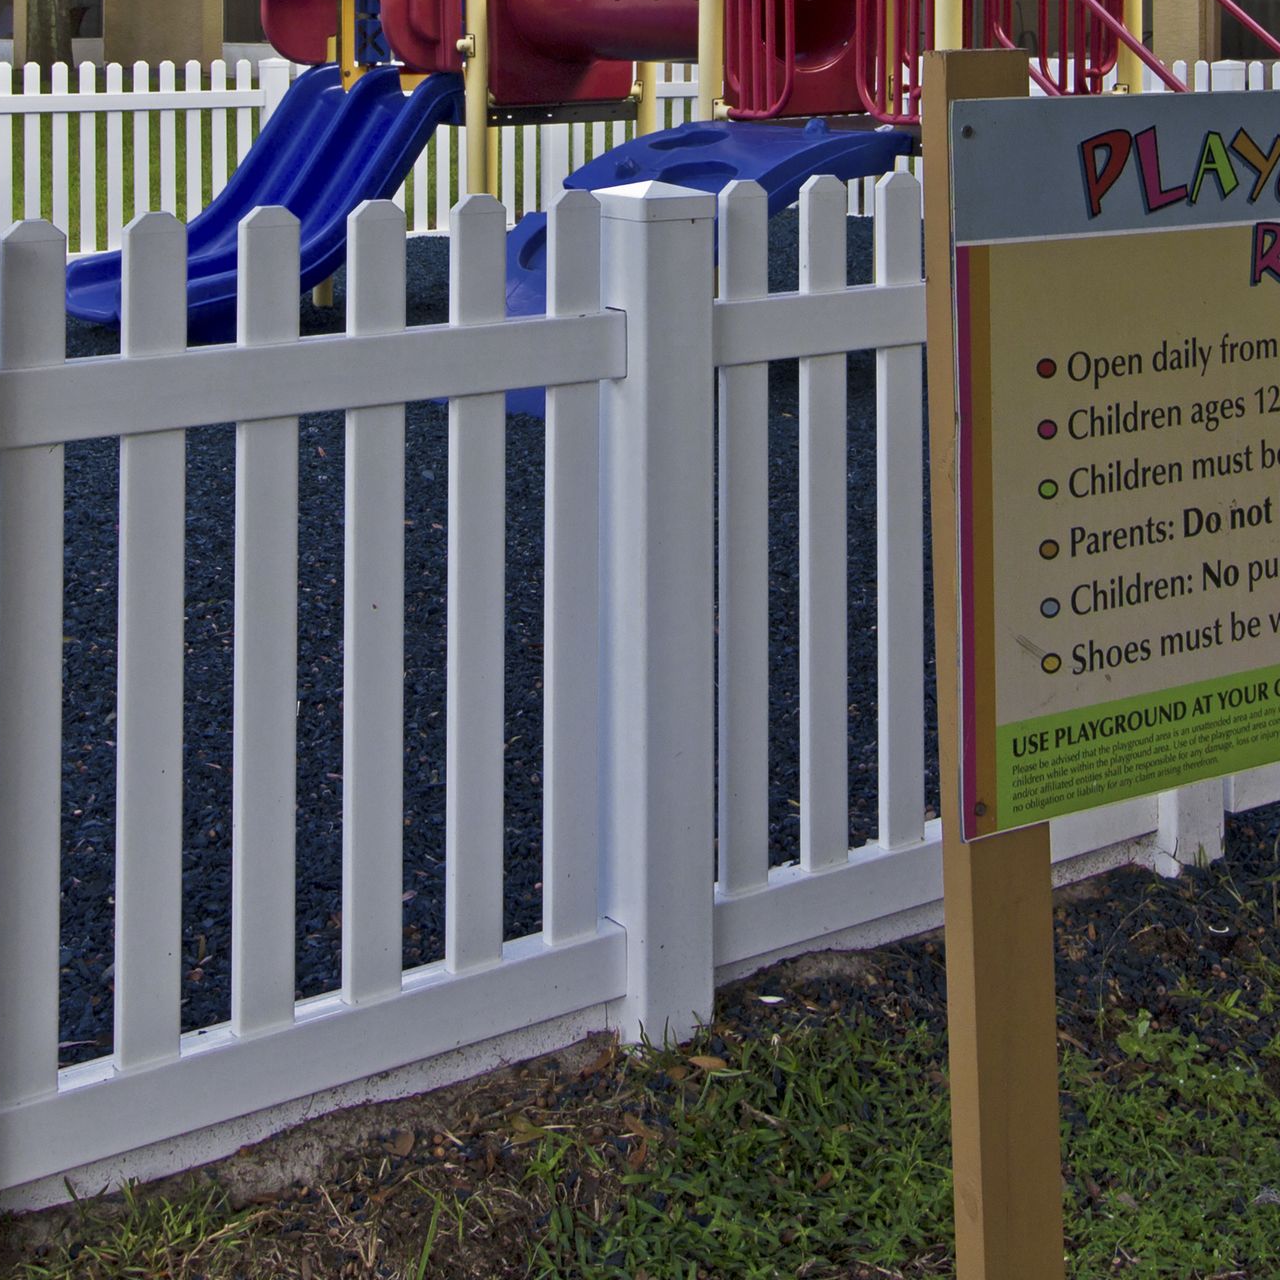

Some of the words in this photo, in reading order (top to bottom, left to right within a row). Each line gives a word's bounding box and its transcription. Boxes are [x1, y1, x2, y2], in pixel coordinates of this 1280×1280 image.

[1068, 351, 1142, 390] Open
[1153, 337, 1212, 376] daily
[1220, 333, 1277, 364] from
[1068, 400, 1181, 440] Children
[1191, 397, 1245, 431] ages
[1254, 385, 1280, 414] 12
[1069, 458, 1182, 498] Children
[1193, 445, 1253, 479] must
[1071, 517, 1174, 557] Parents:
[1184, 508, 1221, 537] Do
[1231, 497, 1272, 529] not
[1071, 572, 1192, 615] Children:
[1203, 560, 1239, 591] No
[1072, 639, 1151, 675] Shoes
[1161, 619, 1223, 656] must
[1231, 611, 1260, 642] be
[1012, 762, 1037, 775] Please
[1039, 757, 1049, 769] be
[1050, 749, 1080, 766] advised
[1081, 746, 1096, 759] that
[1098, 743, 1111, 755] the
[1112, 732, 1154, 754] playground
[1155, 730, 1171, 741] area
[1173, 728, 1179, 737] is
[1180, 726, 1189, 735] an
[1191, 714, 1231, 733] unattended
[1013, 731, 1048, 757] USE
[1055, 701, 1186, 748] PLAYGROUND
[1192, 694, 1213, 717] AT
[1217, 682, 1268, 710] YOUR
[1012, 772, 1044, 787] children
[1045, 765, 1068, 780] while
[1070, 760, 1094, 774] within
[1095, 756, 1108, 768] the
[1109, 745, 1152, 767] playground
[1172, 739, 1187, 750] Use
[1188, 734, 1196, 746] of
[1197, 732, 1210, 744] the
[1012, 786, 1038, 800] and/or
[1039, 776, 1074, 794] affiliated
[1075, 771, 1102, 785] entities
[1103, 764, 1123, 779] shall
[1123, 763, 1134, 774] be
[1135, 752, 1176, 771] responsible
[1177, 750, 1188, 761] for
[1189, 748, 1202, 759] any
[1012, 803, 1023, 813] no
[1024, 793, 1065, 810] obligation
[1065, 790, 1074, 800] or
[1106, 779, 1117, 790] for
[1118, 776, 1132, 787] any
[1134, 771, 1155, 783] claim
[1157, 765, 1181, 778] arising
